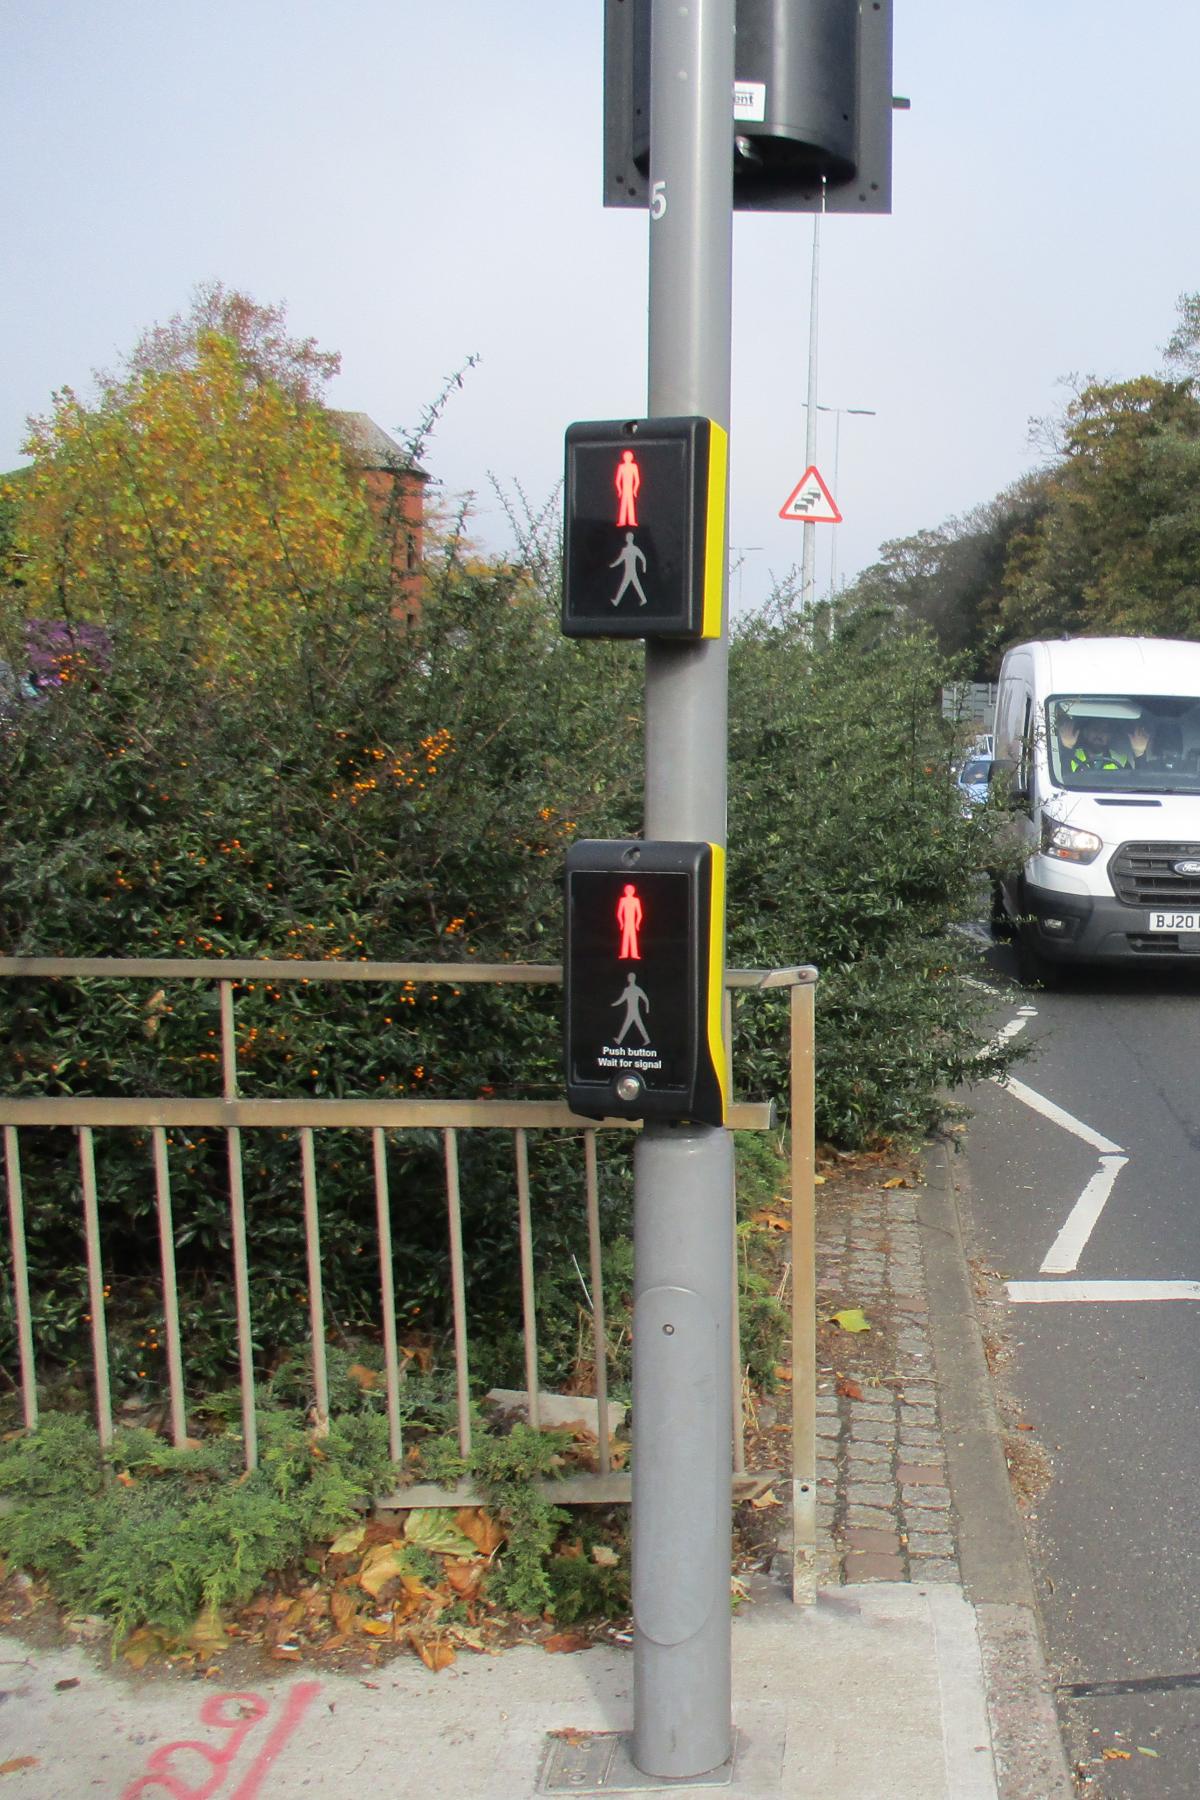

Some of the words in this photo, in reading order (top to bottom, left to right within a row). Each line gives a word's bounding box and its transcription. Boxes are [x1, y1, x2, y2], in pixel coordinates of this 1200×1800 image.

[651, 181, 667, 221] 5
[1156, 915, 1194, 928] BJ20
[602, 1046, 626, 1056] Push
[628, 1047, 657, 1057] button
[598, 1058, 618, 1067] Wait
[619, 1059, 633, 1068] for
[634, 1060, 662, 1070] signal
